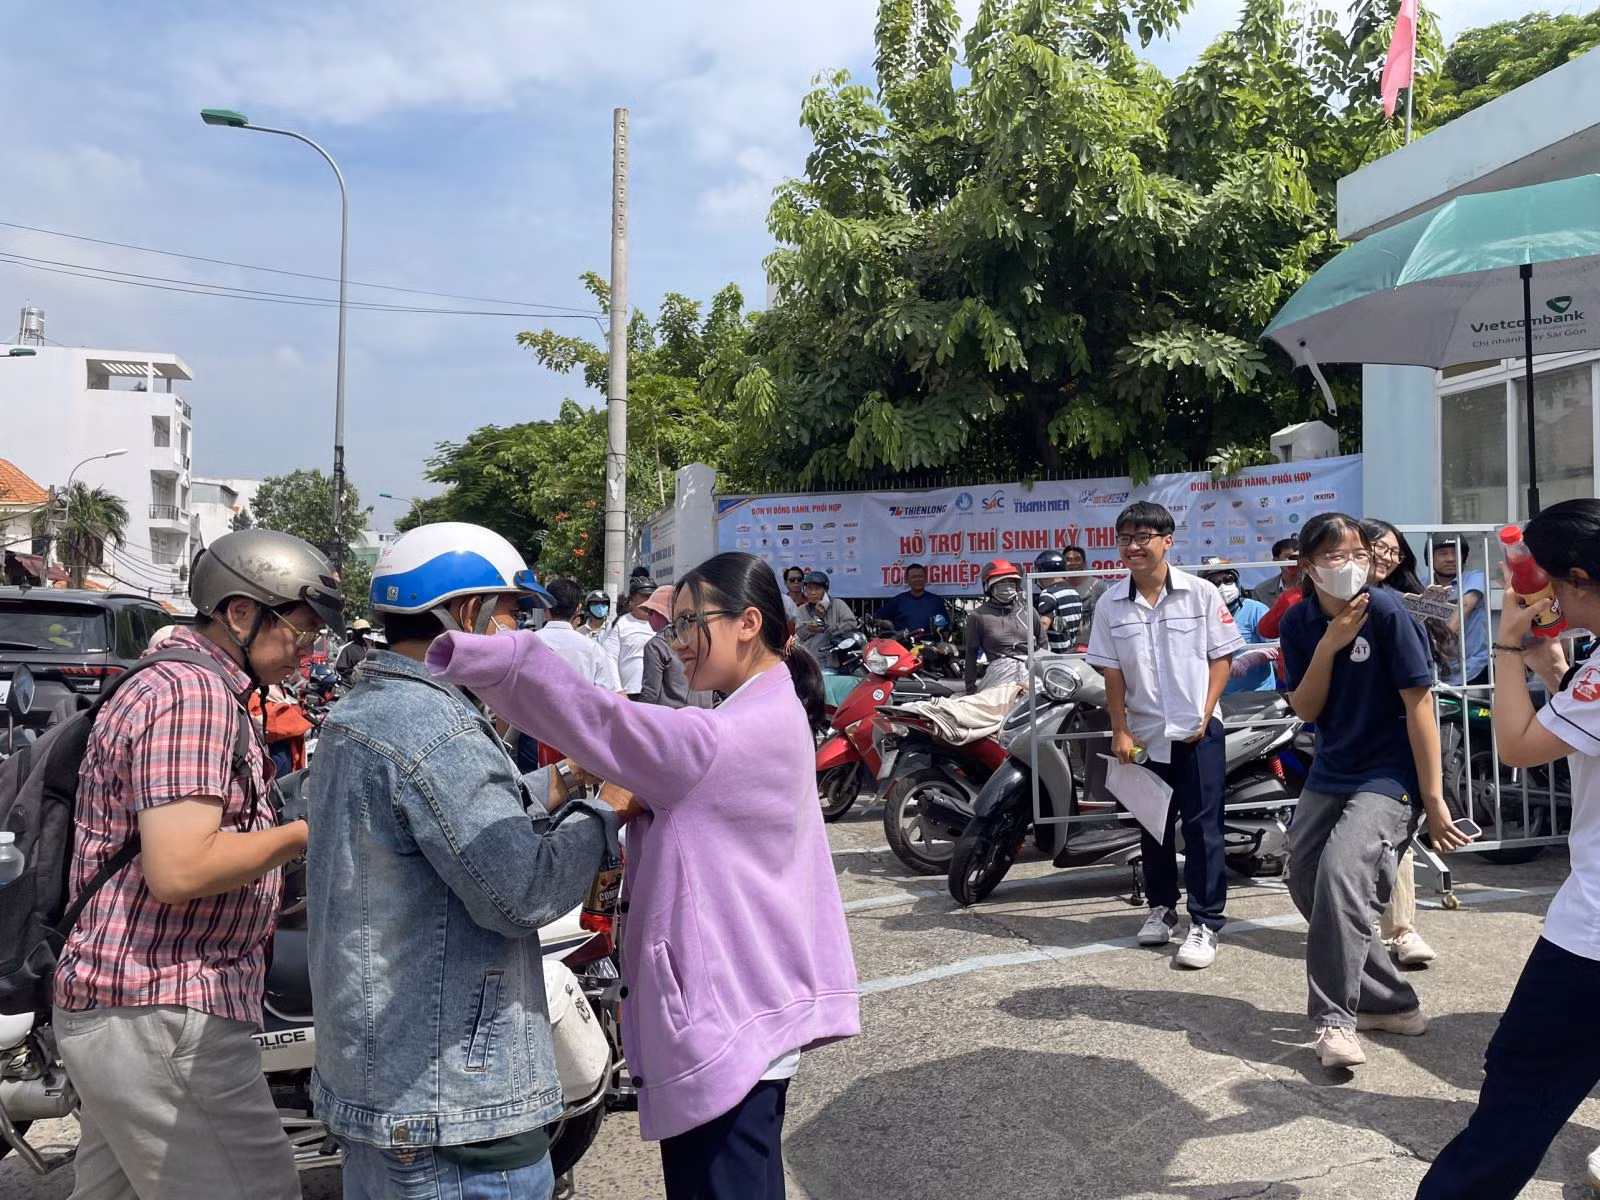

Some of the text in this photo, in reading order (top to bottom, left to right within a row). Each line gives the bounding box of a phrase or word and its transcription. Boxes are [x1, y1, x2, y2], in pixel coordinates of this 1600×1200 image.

[1470, 310, 1585, 333] Vietcombank
[899, 523, 1115, 556] HỖ TRỢ THÍ SINH KỲ THI
[1091, 560, 1128, 580] 202
[251, 1030, 307, 1047] OLICE
